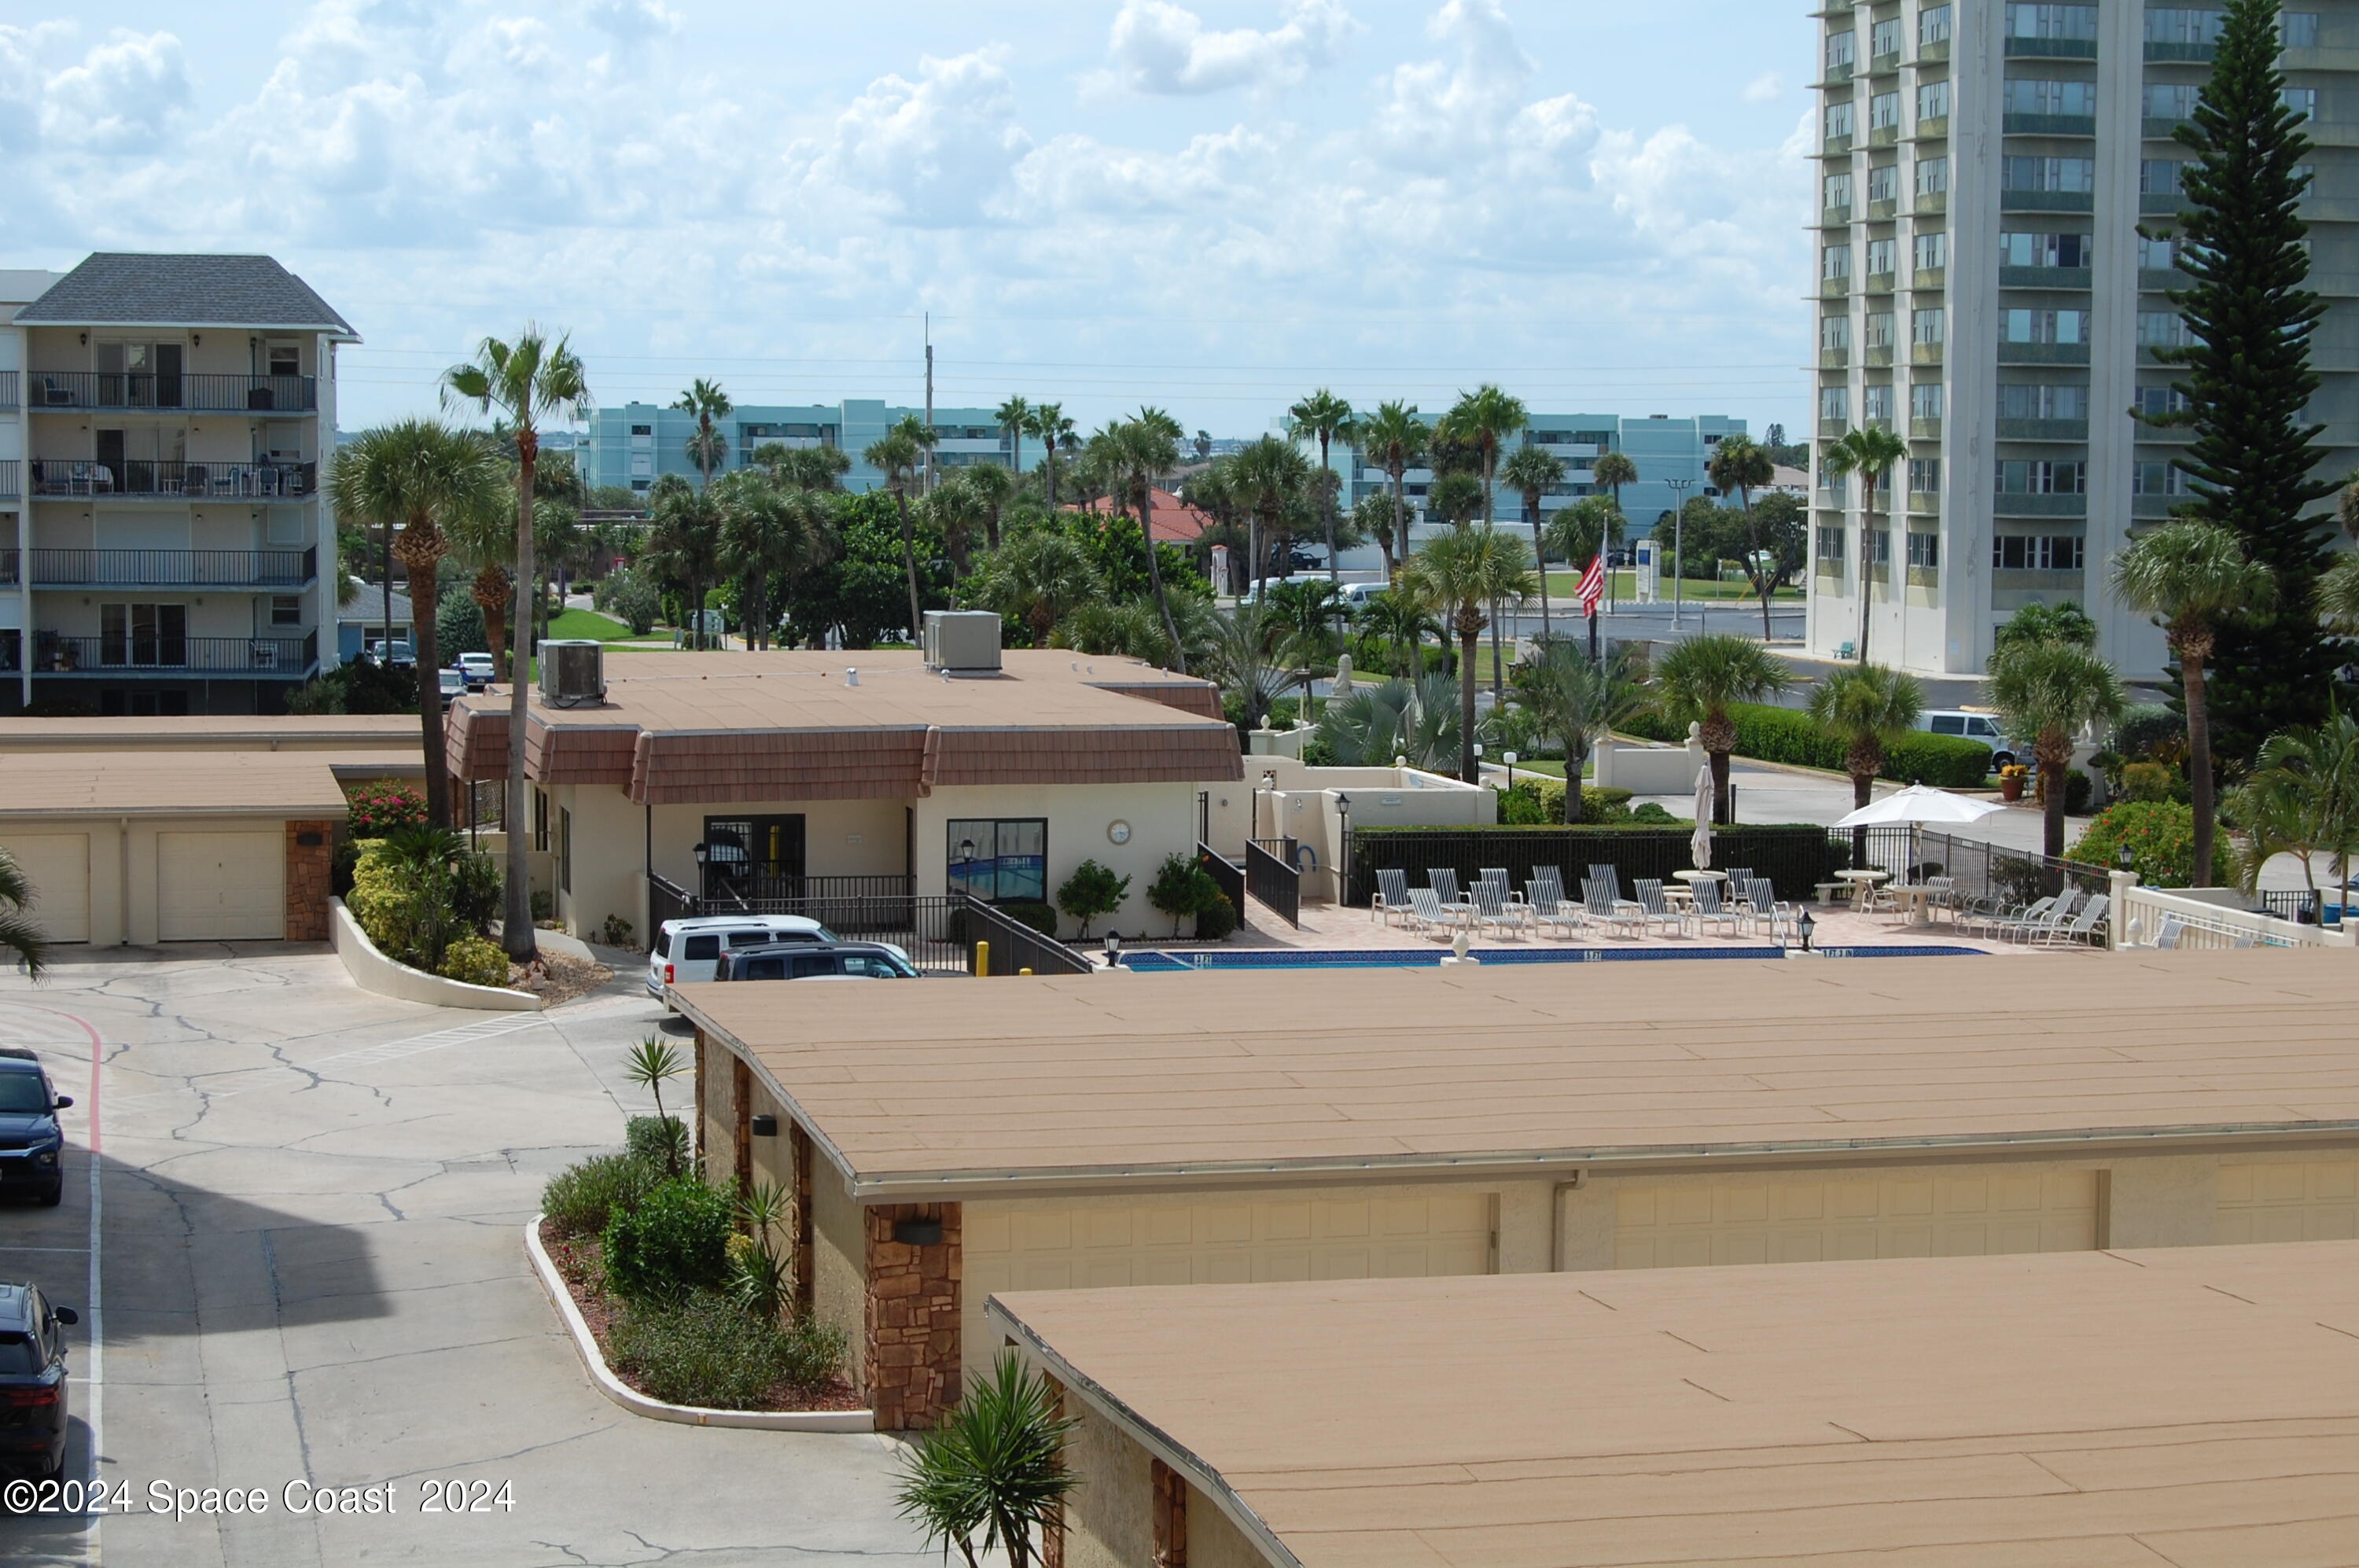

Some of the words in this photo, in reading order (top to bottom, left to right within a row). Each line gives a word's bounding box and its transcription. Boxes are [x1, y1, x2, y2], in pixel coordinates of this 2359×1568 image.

[1829, 949, 1837, 958] FT
[1846, 949, 1853, 958] IN
[1203, 955, 1211, 963] FT
